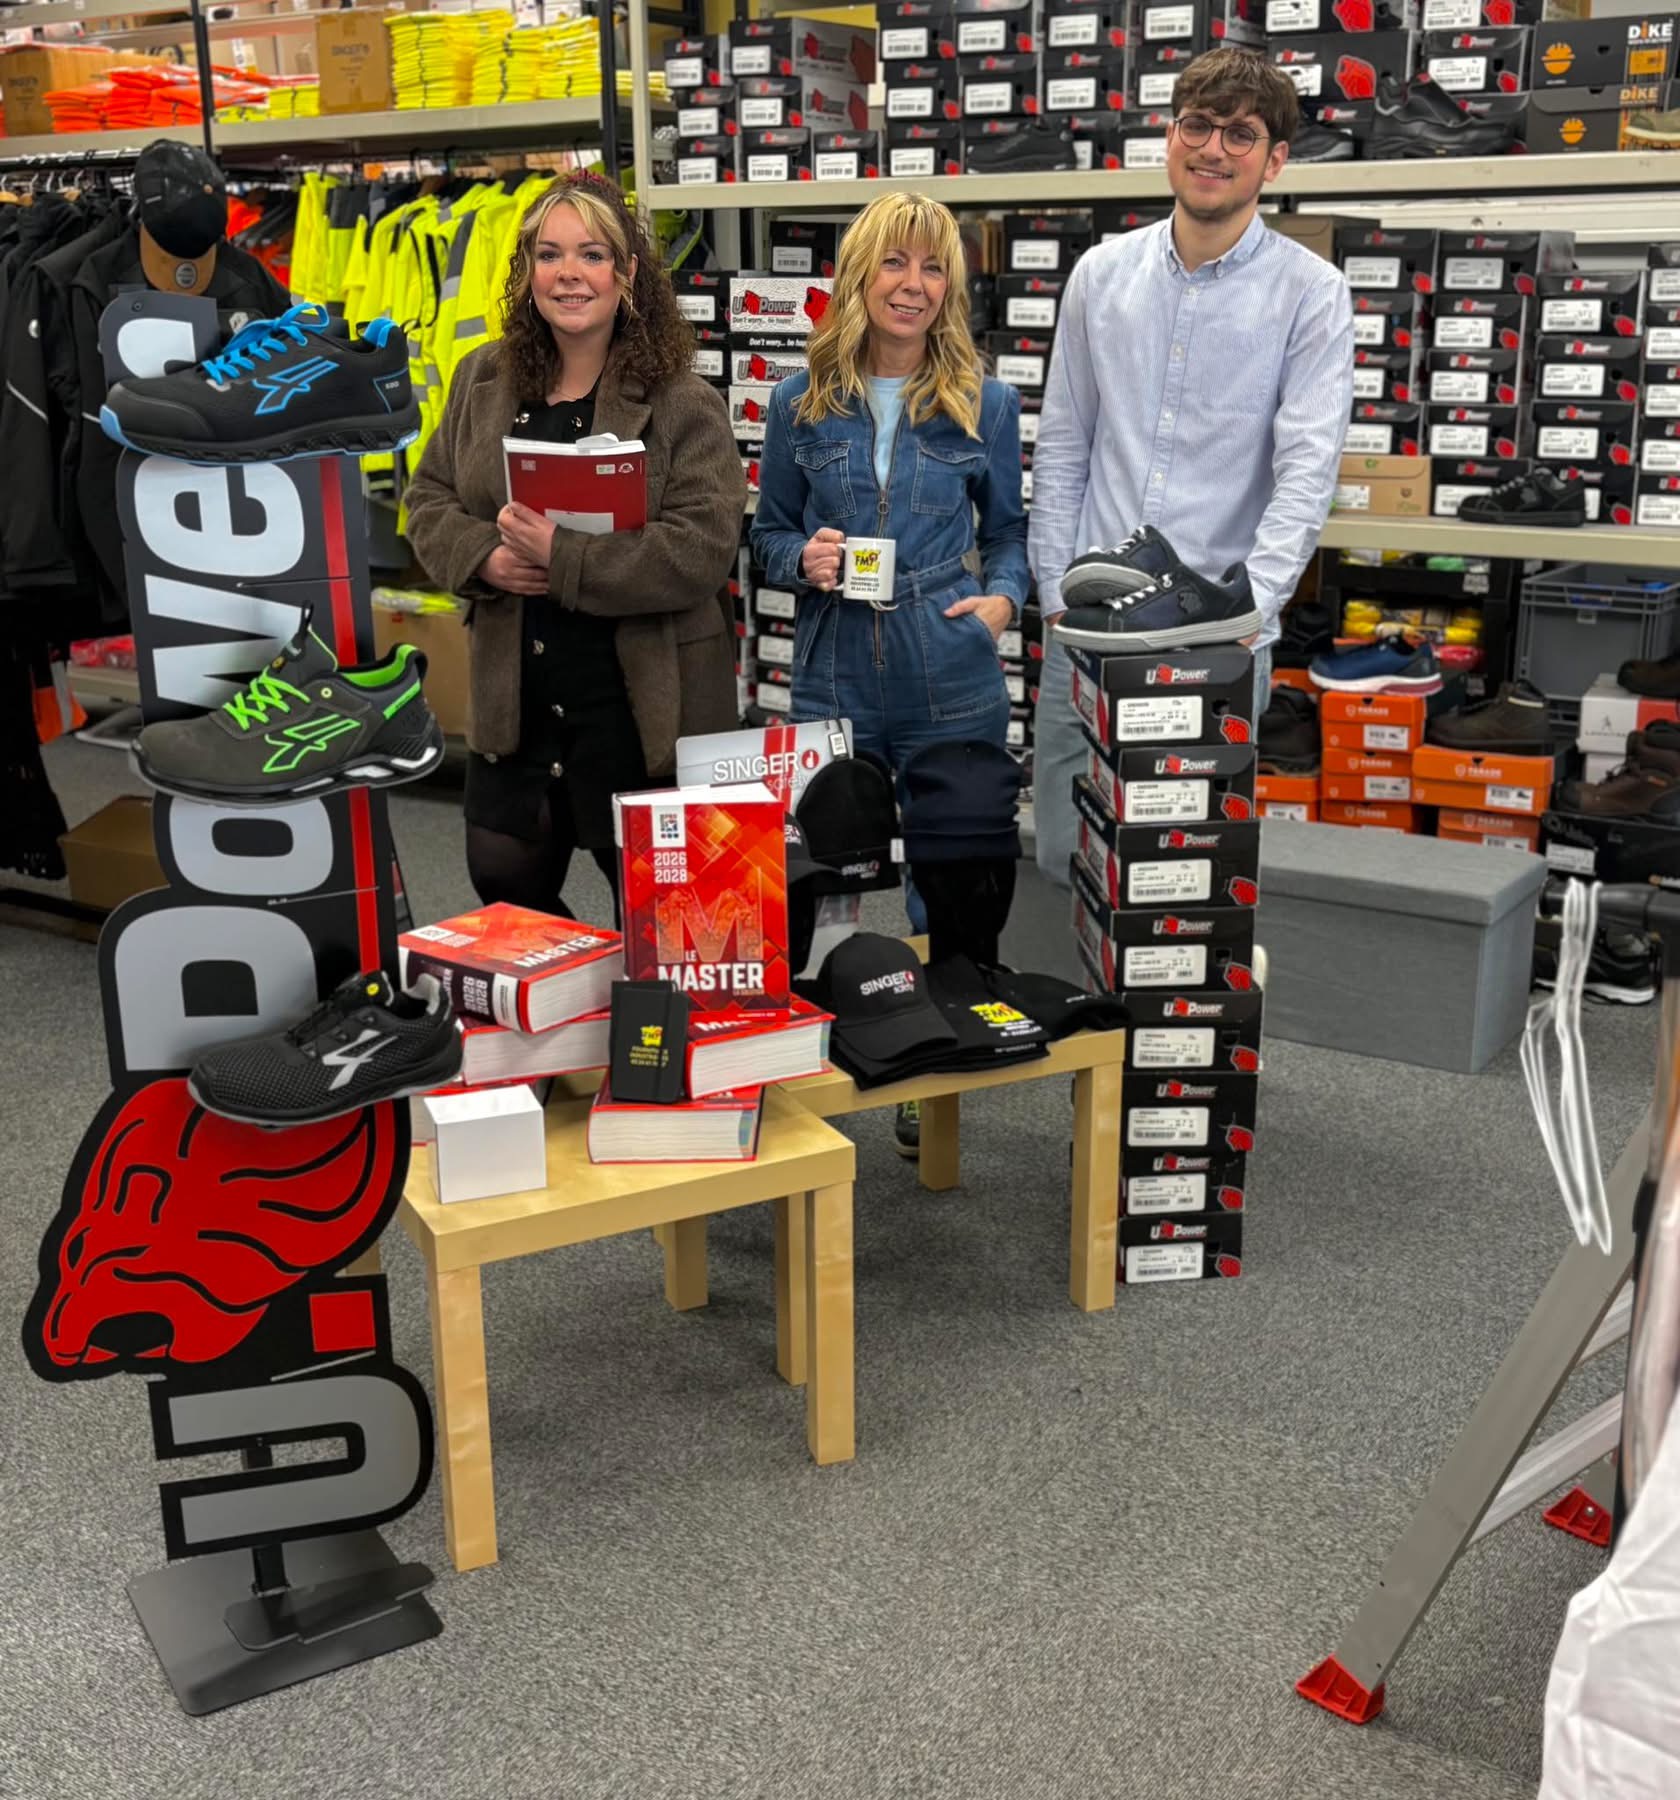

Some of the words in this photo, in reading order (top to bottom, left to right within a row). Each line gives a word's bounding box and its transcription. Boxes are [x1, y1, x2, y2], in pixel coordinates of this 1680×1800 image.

[749, 338, 765, 346] Don't
[787, 338, 795, 346] be
[1172, 668, 1210, 683] Power
[714, 752, 800, 782] SINGER
[1180, 759, 1218, 773] Power
[1183, 833, 1222, 847] Power
[654, 852, 688, 867] 2026
[655, 869, 688, 884] 2028
[1178, 920, 1215, 934] Power
[513, 935, 604, 968] MASTER
[685, 950, 697, 963] LE
[657, 963, 764, 992] MASTER
[463, 976, 477, 1011] 2026
[475, 980, 490, 1016] 2028
[1188, 1001, 1225, 1016] Power
[1181, 1084, 1217, 1097] Power
[1176, 1156, 1211, 1170] Power
[1174, 1224, 1207, 1238] Power
